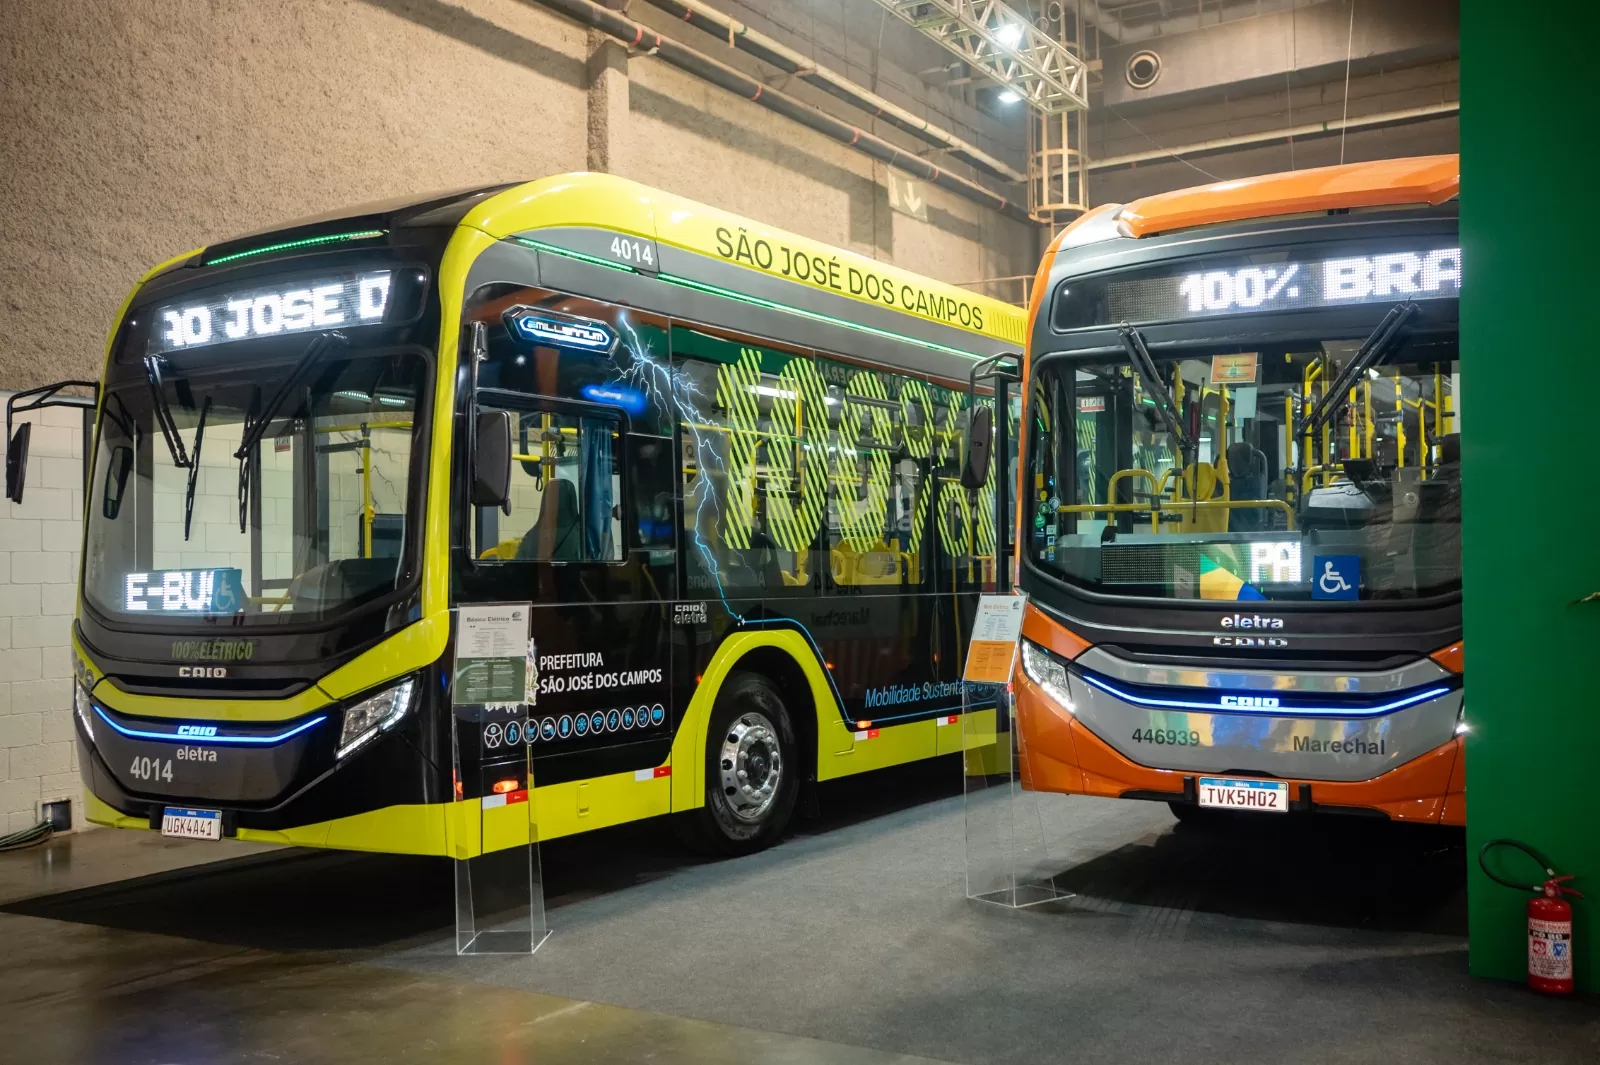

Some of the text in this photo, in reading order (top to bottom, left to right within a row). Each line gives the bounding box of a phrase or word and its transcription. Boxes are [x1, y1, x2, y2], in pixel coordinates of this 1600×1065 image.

[610, 237, 653, 265] 4014
[716, 227, 984, 330] SÃO JOSÉ DOS CAMPOS
[1180, 248, 1462, 312] 100% BRA
[225, 285, 345, 338] JOSE
[675, 604, 700, 612] CAIO
[674, 611, 707, 625] eletra
[1220, 614, 1284, 629] eletra
[1213, 635, 1288, 647] CAIO
[540, 652, 604, 671] PREFEITURA
[178, 667, 227, 678] CAIO
[540, 668, 662, 694] SÃO JOSÉ DOS CAMPOS
[864, 687, 921, 708] Mobilidade
[1220, 695, 1280, 708] CAIO
[177, 725, 218, 737] CAIO
[1131, 728, 1201, 747] 446939
[176, 745, 218, 762] eletra
[1293, 735, 1386, 756] Marechal
[130, 756, 174, 783] 4014
[1207, 788, 1277, 808] TVK5H02
[166, 817, 213, 836] UGK4A41
